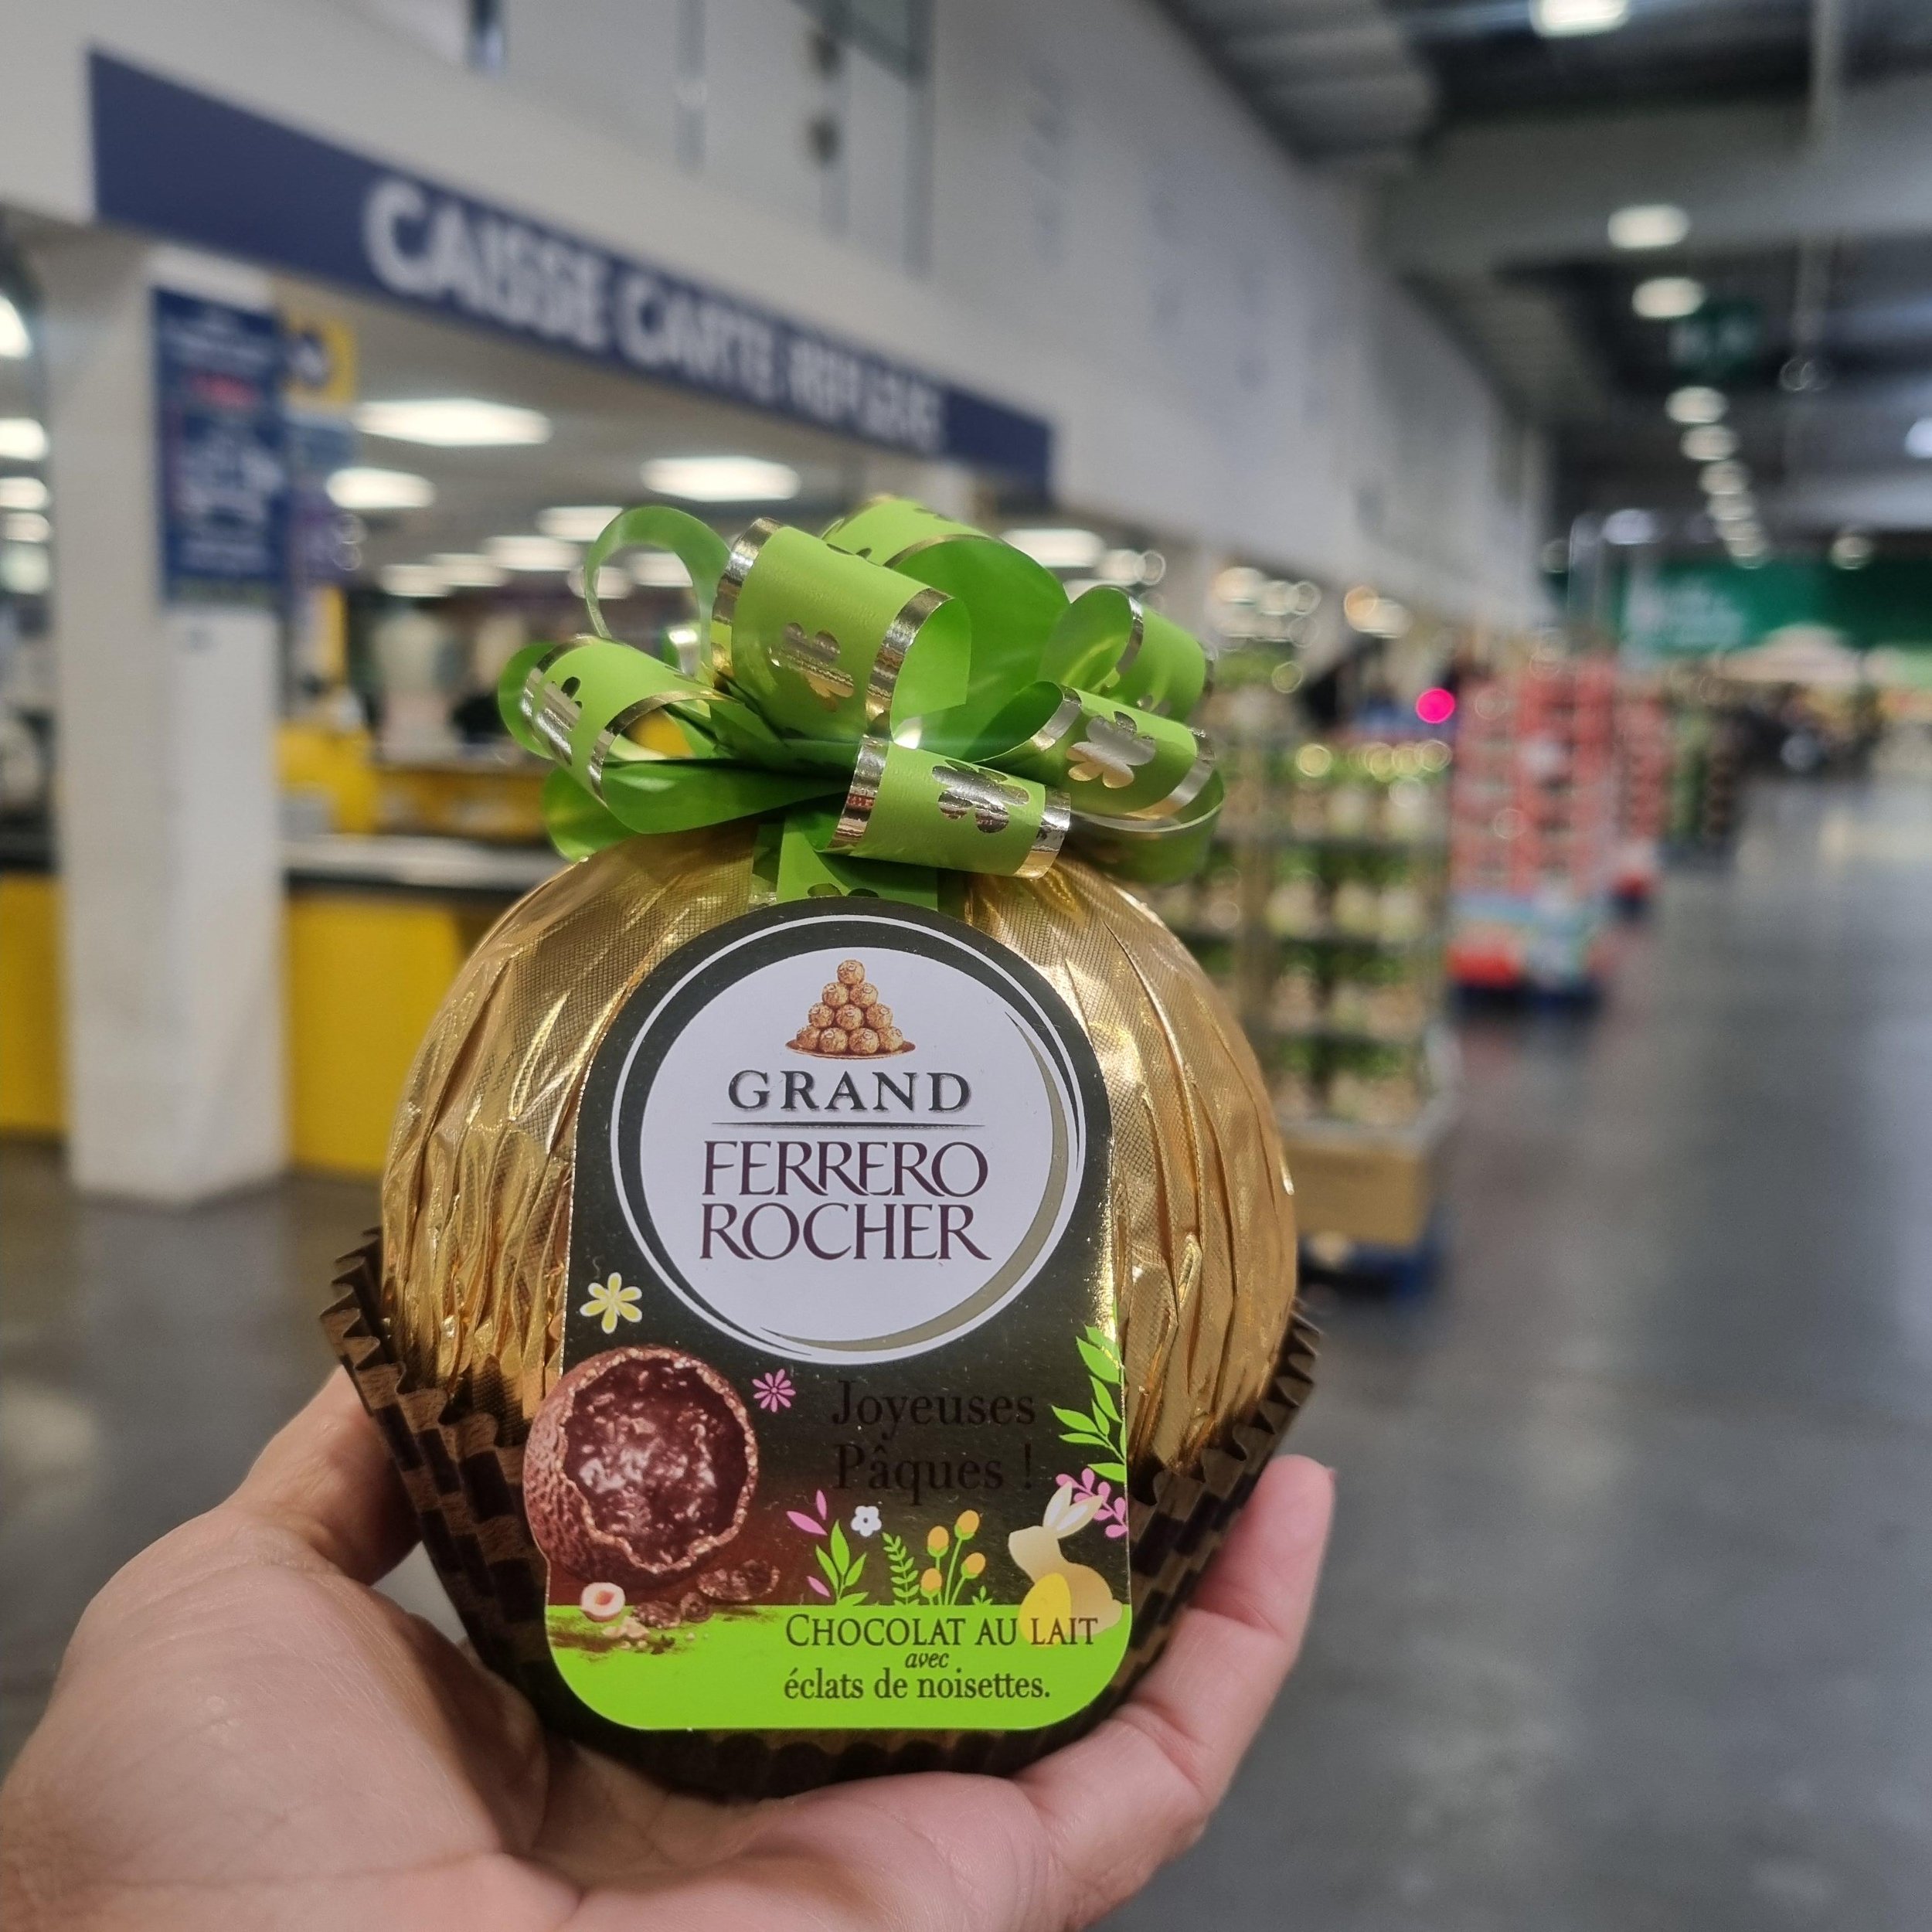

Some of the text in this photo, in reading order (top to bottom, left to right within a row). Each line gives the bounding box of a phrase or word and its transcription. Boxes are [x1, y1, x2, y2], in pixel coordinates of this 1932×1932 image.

[363, 179, 609, 351] CAISSE
[728, 1069, 972, 1114] GRAND
[702, 1140, 989, 1198] FERRERO
[699, 1202, 992, 1261] ROCHER
[832, 1379, 1036, 1440] Joyeuses
[835, 1443, 1005, 1506] Pâques
[785, 1614, 1099, 1647] CHOCOLAT AU LAIT
[784, 1667, 1051, 1699] éclats de noisettes.
[904, 1651, 950, 1669] avec
